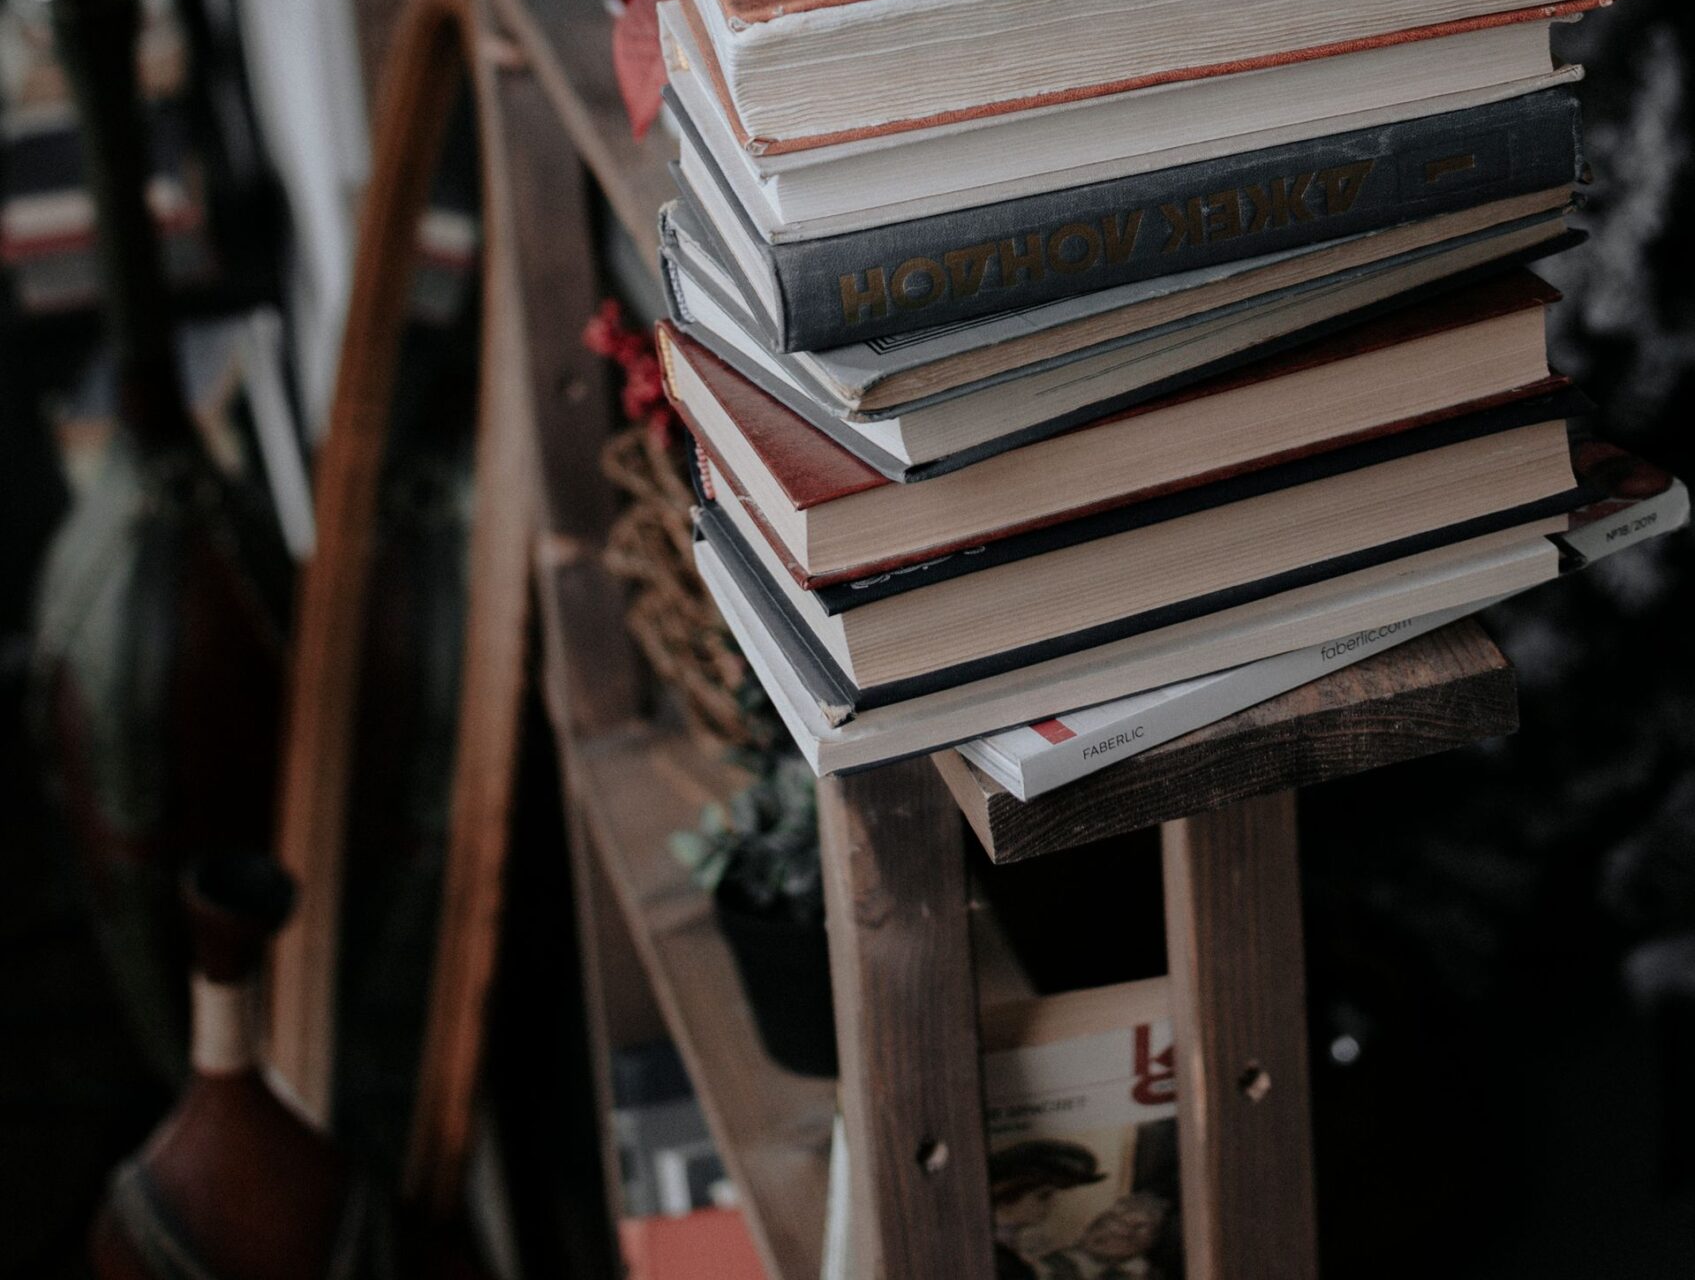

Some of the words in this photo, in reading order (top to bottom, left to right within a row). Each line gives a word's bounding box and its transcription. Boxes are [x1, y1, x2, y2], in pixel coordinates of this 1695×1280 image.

[1162, 159, 1376, 254] ДЖЕК
[839, 208, 1145, 323] ЛОНДОН
[1321, 618, 1413, 661] faberlic.com
[1082, 726, 1144, 760] FABERLIC
